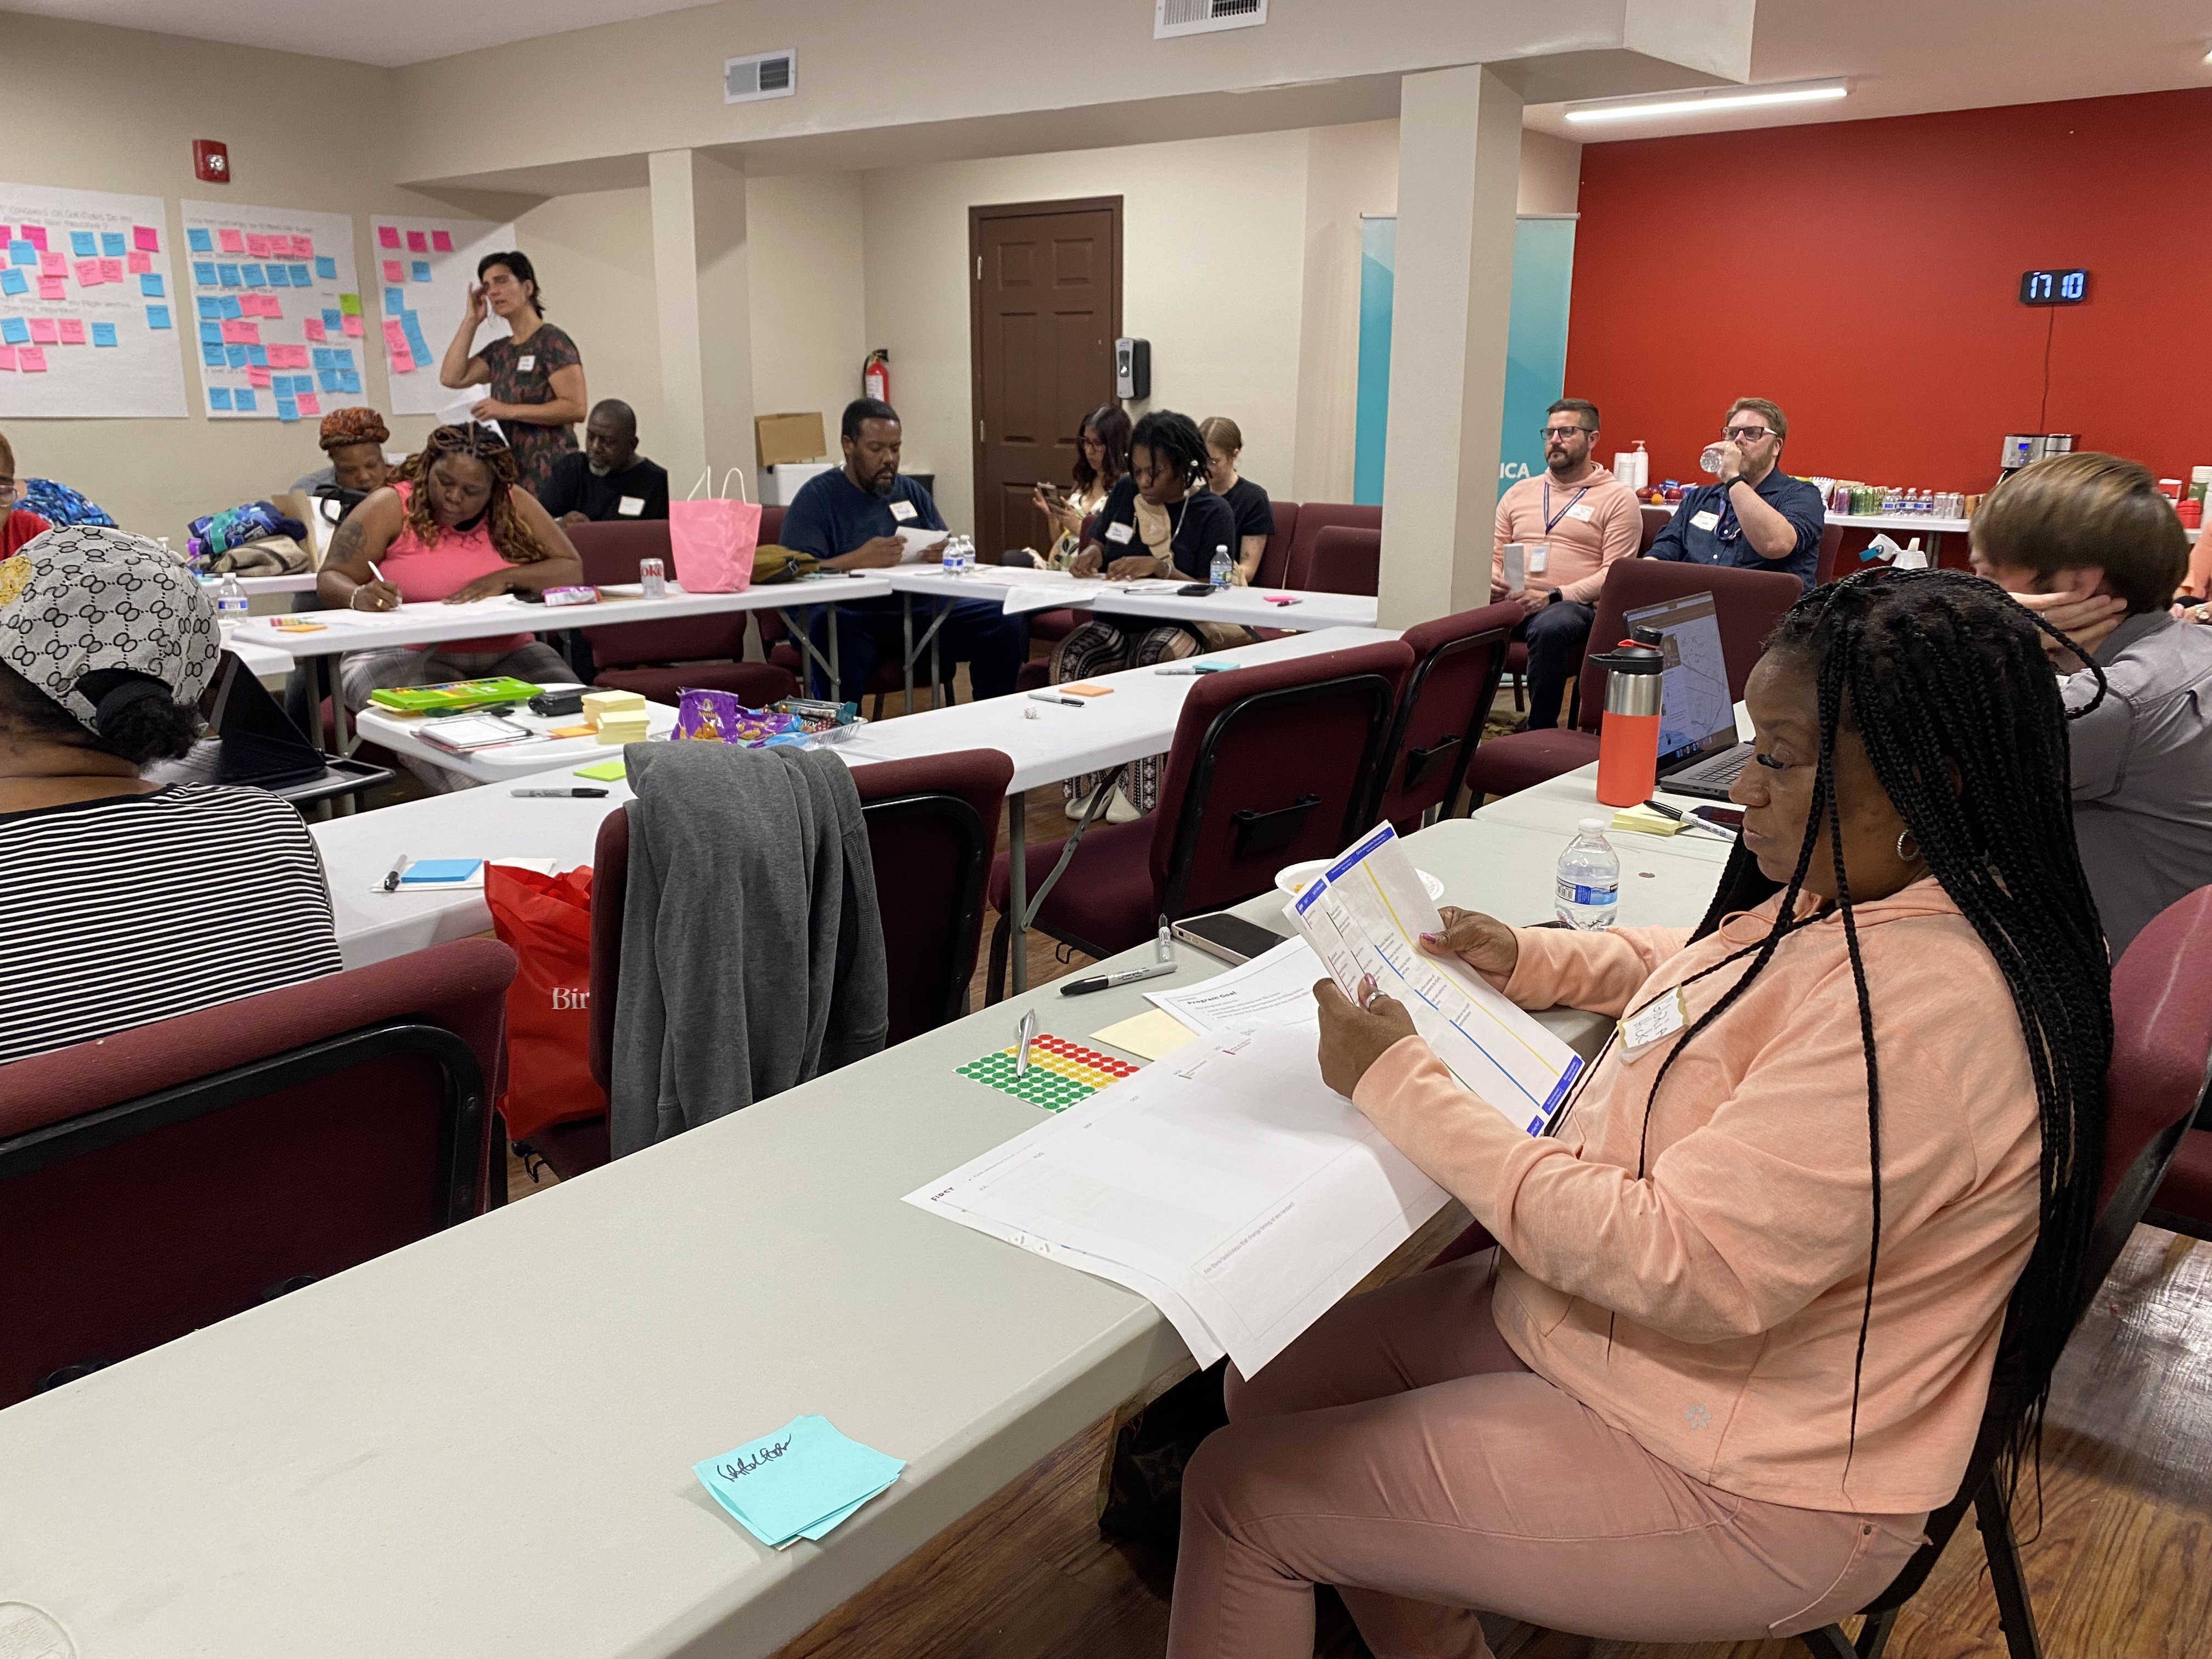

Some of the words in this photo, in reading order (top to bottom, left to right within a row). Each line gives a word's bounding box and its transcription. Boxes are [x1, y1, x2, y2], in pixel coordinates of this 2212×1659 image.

[1499, 462, 1530, 479] ICA
[551, 987, 590, 1010] Bir
[1187, 996, 1219, 1005] Program
